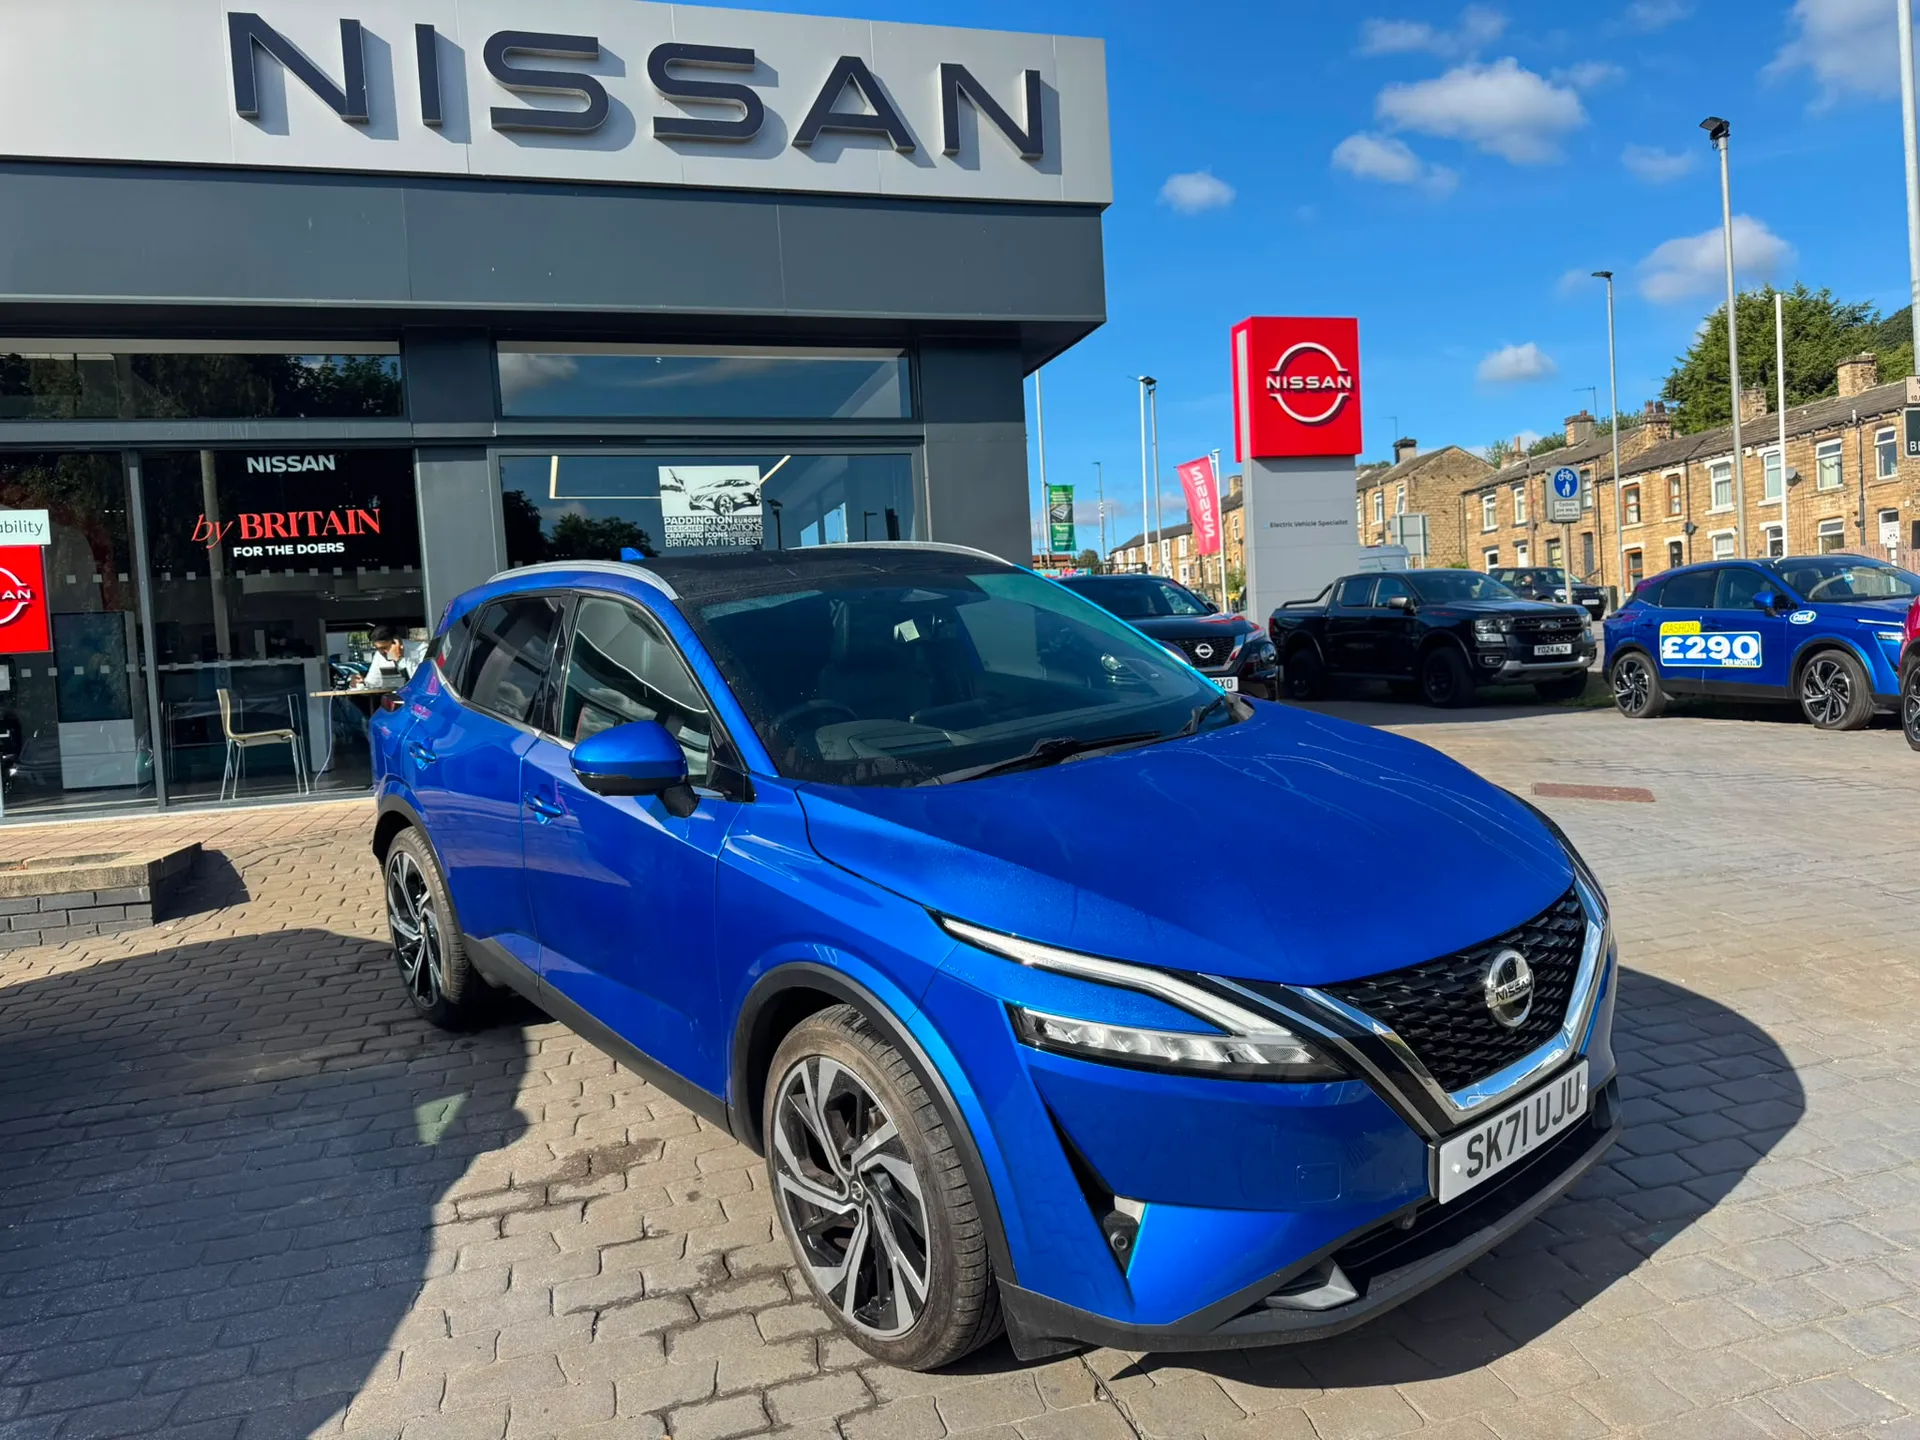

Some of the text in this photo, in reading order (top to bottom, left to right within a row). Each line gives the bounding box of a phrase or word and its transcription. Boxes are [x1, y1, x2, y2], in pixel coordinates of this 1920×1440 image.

[228, 12, 1044, 160] NISSAN
[1266, 376, 1352, 389] NISSAN
[246, 455, 336, 473] NISSAN
[664, 516, 732, 525] PADDINGTON
[705, 524, 763, 532] INNOVATIONS
[1318, 519, 1348, 527] Specialist
[191, 509, 380, 549] by BRITAIN
[233, 542, 345, 557] FOR THE DOERS
[665, 537, 763, 547] BRITAIN AT ITS BEST
[1662, 635, 1759, 660] £290
[1466, 1071, 1581, 1178] SK71 UJU
